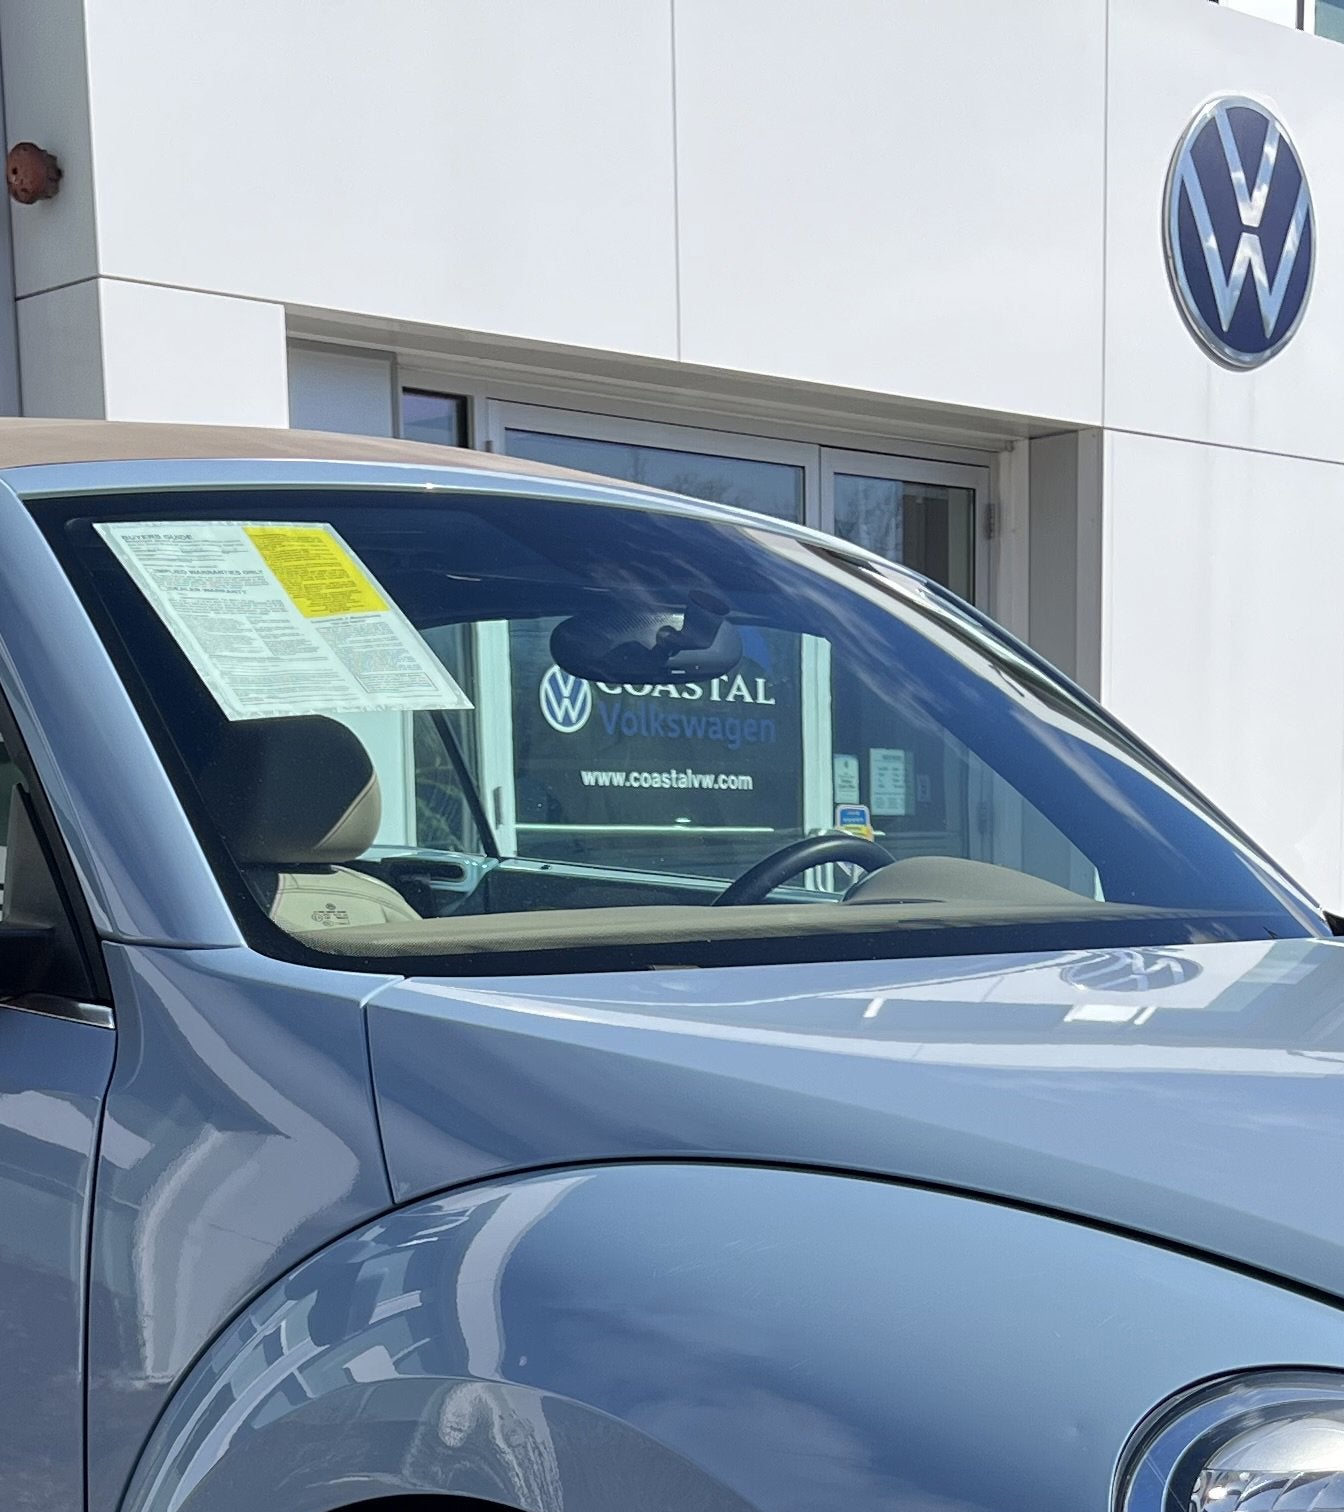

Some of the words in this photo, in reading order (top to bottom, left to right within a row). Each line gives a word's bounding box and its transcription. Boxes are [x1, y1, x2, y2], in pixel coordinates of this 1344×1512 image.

[1168, 98, 1314, 364] VW
[598, 702, 777, 749] Volkswagen
[580, 768, 754, 791] www.coastalvw.com
